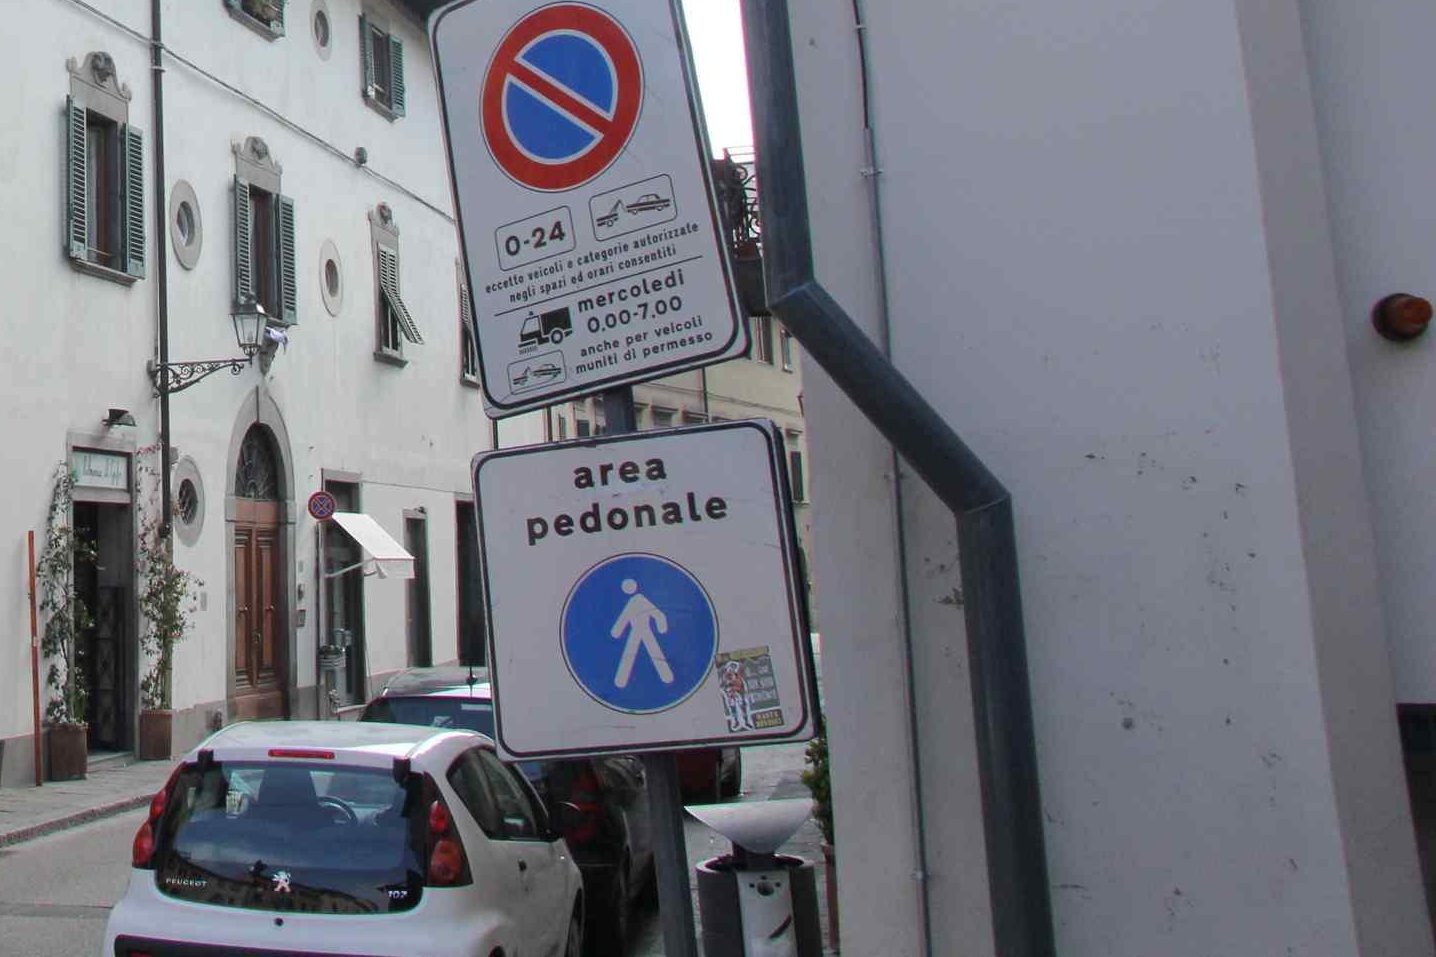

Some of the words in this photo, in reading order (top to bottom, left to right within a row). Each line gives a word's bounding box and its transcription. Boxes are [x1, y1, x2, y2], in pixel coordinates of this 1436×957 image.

[485, 272, 524, 294] eccetto
[528, 260, 564, 281] veicoli
[567, 259, 574, 269] e
[576, 242, 630, 267] categorie
[633, 222, 699, 249] autorizzate
[504, 220, 567, 257] 0-24
[509, 284, 537, 303] negli
[539, 275, 567, 294] spazi
[571, 270, 584, 285] ed
[587, 264, 615, 280] orari
[618, 244, 677, 271] consentiti
[587, 295, 683, 334] 0.00-7.00
[576, 355, 619, 375] muniti
[623, 349, 637, 361] di
[643, 331, 713, 359] permesso
[580, 340, 620, 358] anche
[625, 331, 648, 346] per
[654, 315, 704, 338] veicoli
[573, 456, 668, 490] area
[526, 491, 729, 546] pedonale
